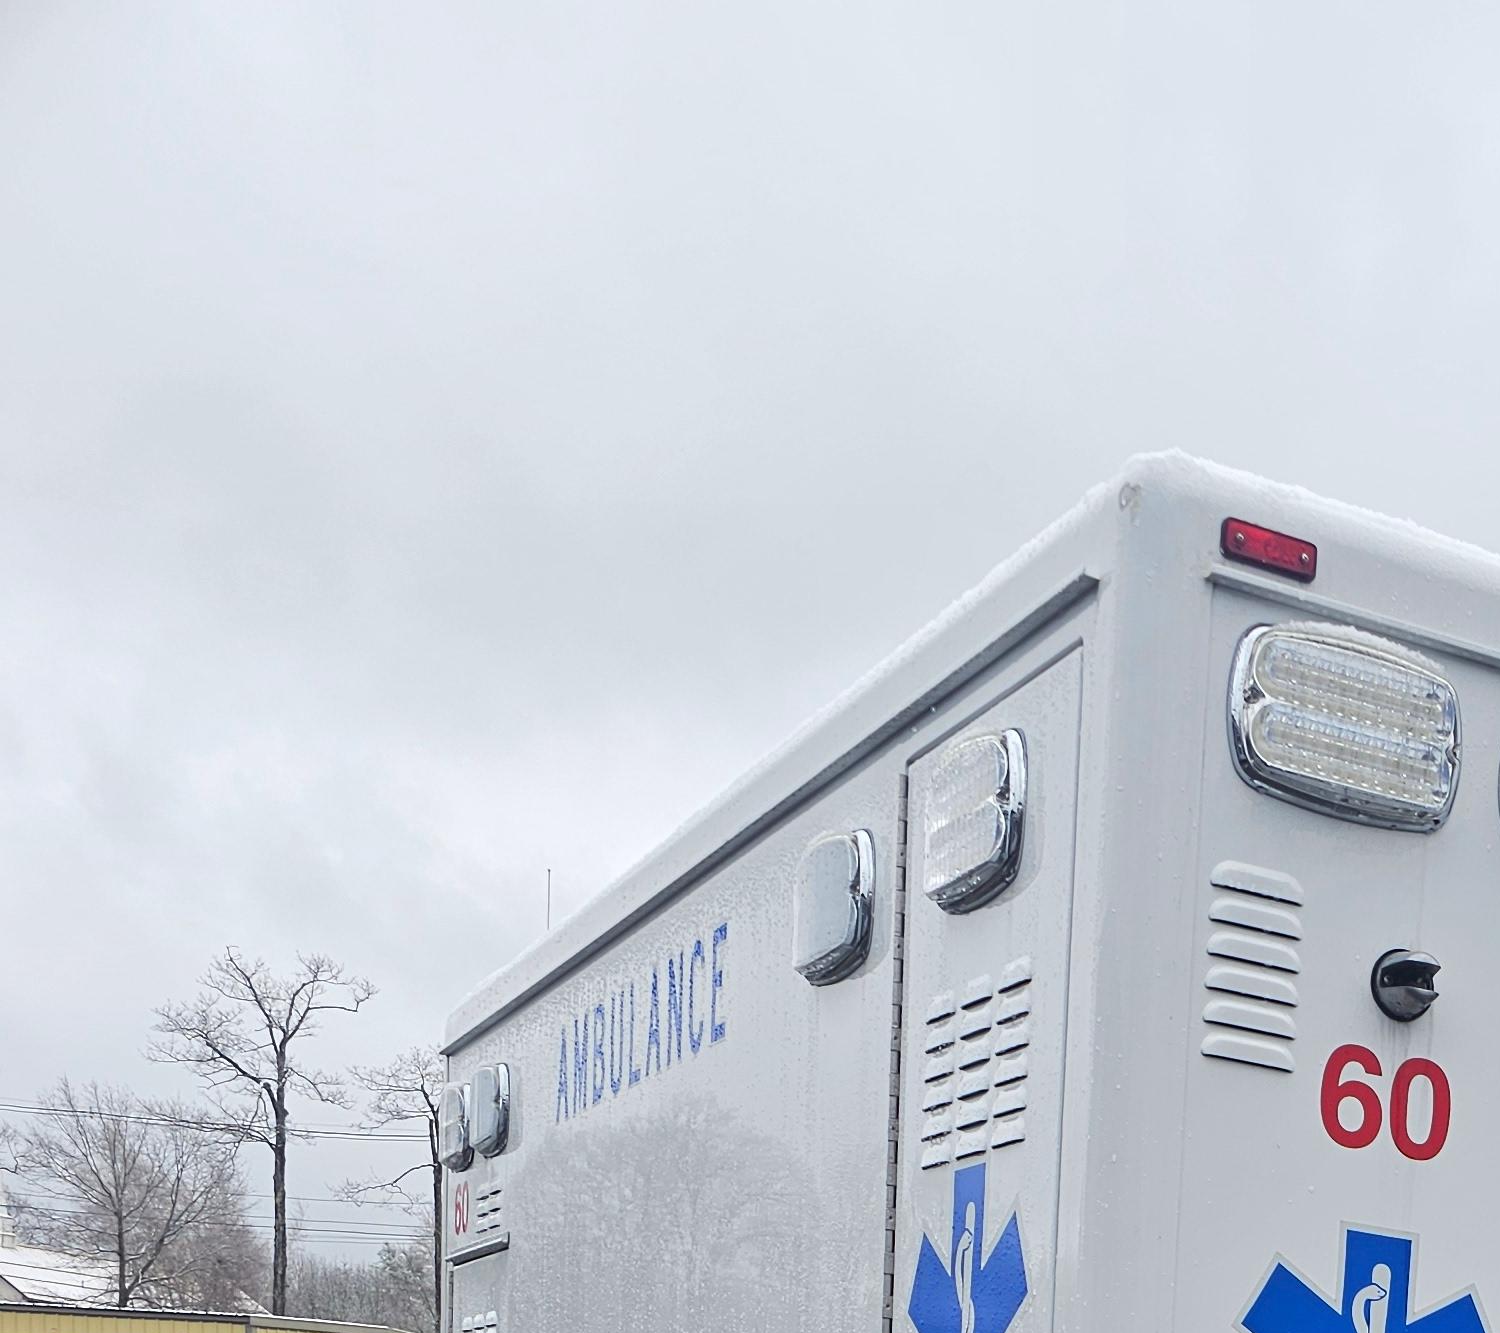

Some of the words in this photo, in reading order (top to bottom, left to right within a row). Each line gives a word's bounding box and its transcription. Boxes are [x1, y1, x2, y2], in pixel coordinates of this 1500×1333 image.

[556, 922, 728, 1125] AMBULANCE
[1320, 1043, 1451, 1161] 60
[454, 1181, 469, 1235] 60
